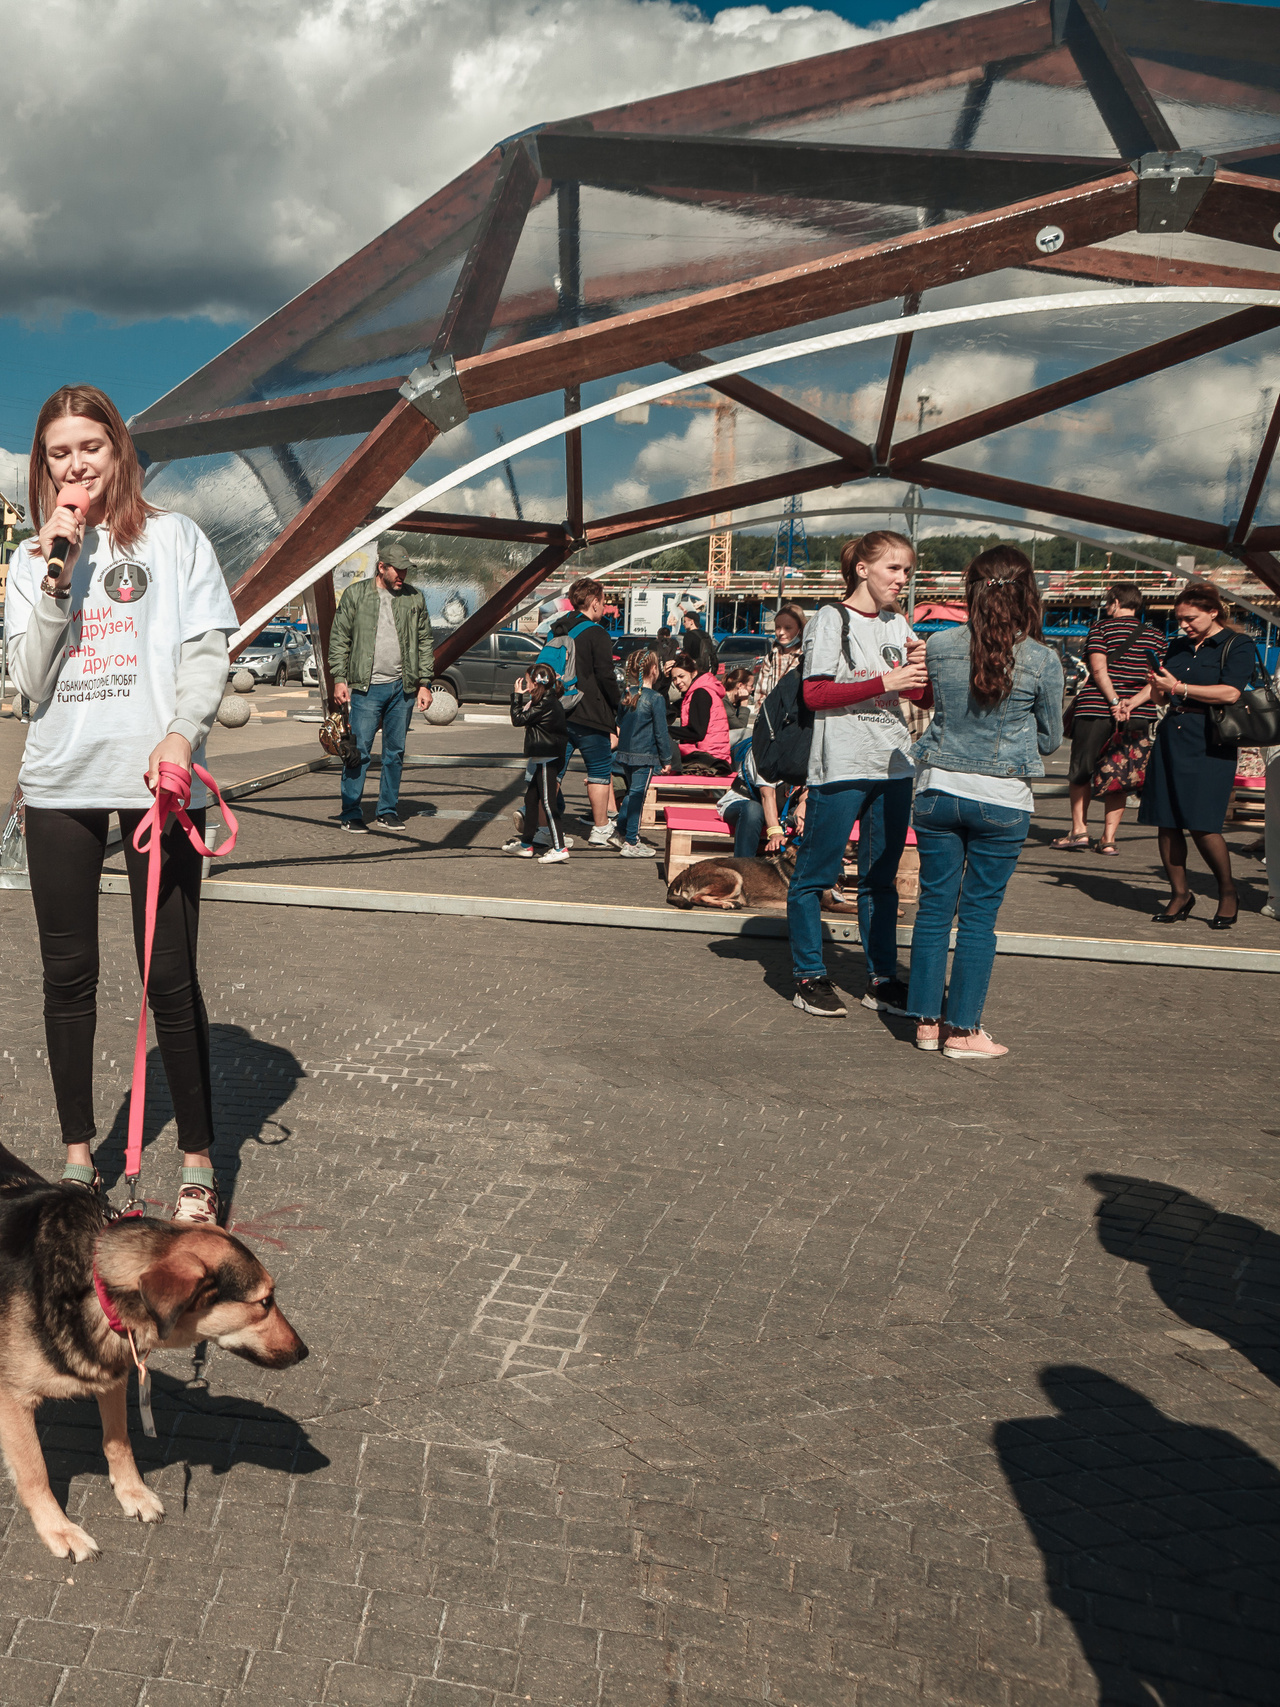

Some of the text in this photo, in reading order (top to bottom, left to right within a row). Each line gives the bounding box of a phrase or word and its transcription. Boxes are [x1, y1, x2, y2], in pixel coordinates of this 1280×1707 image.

[72, 606, 113, 623] ищи
[80, 616, 138, 641] друзей,
[82, 655, 137, 674] другом
